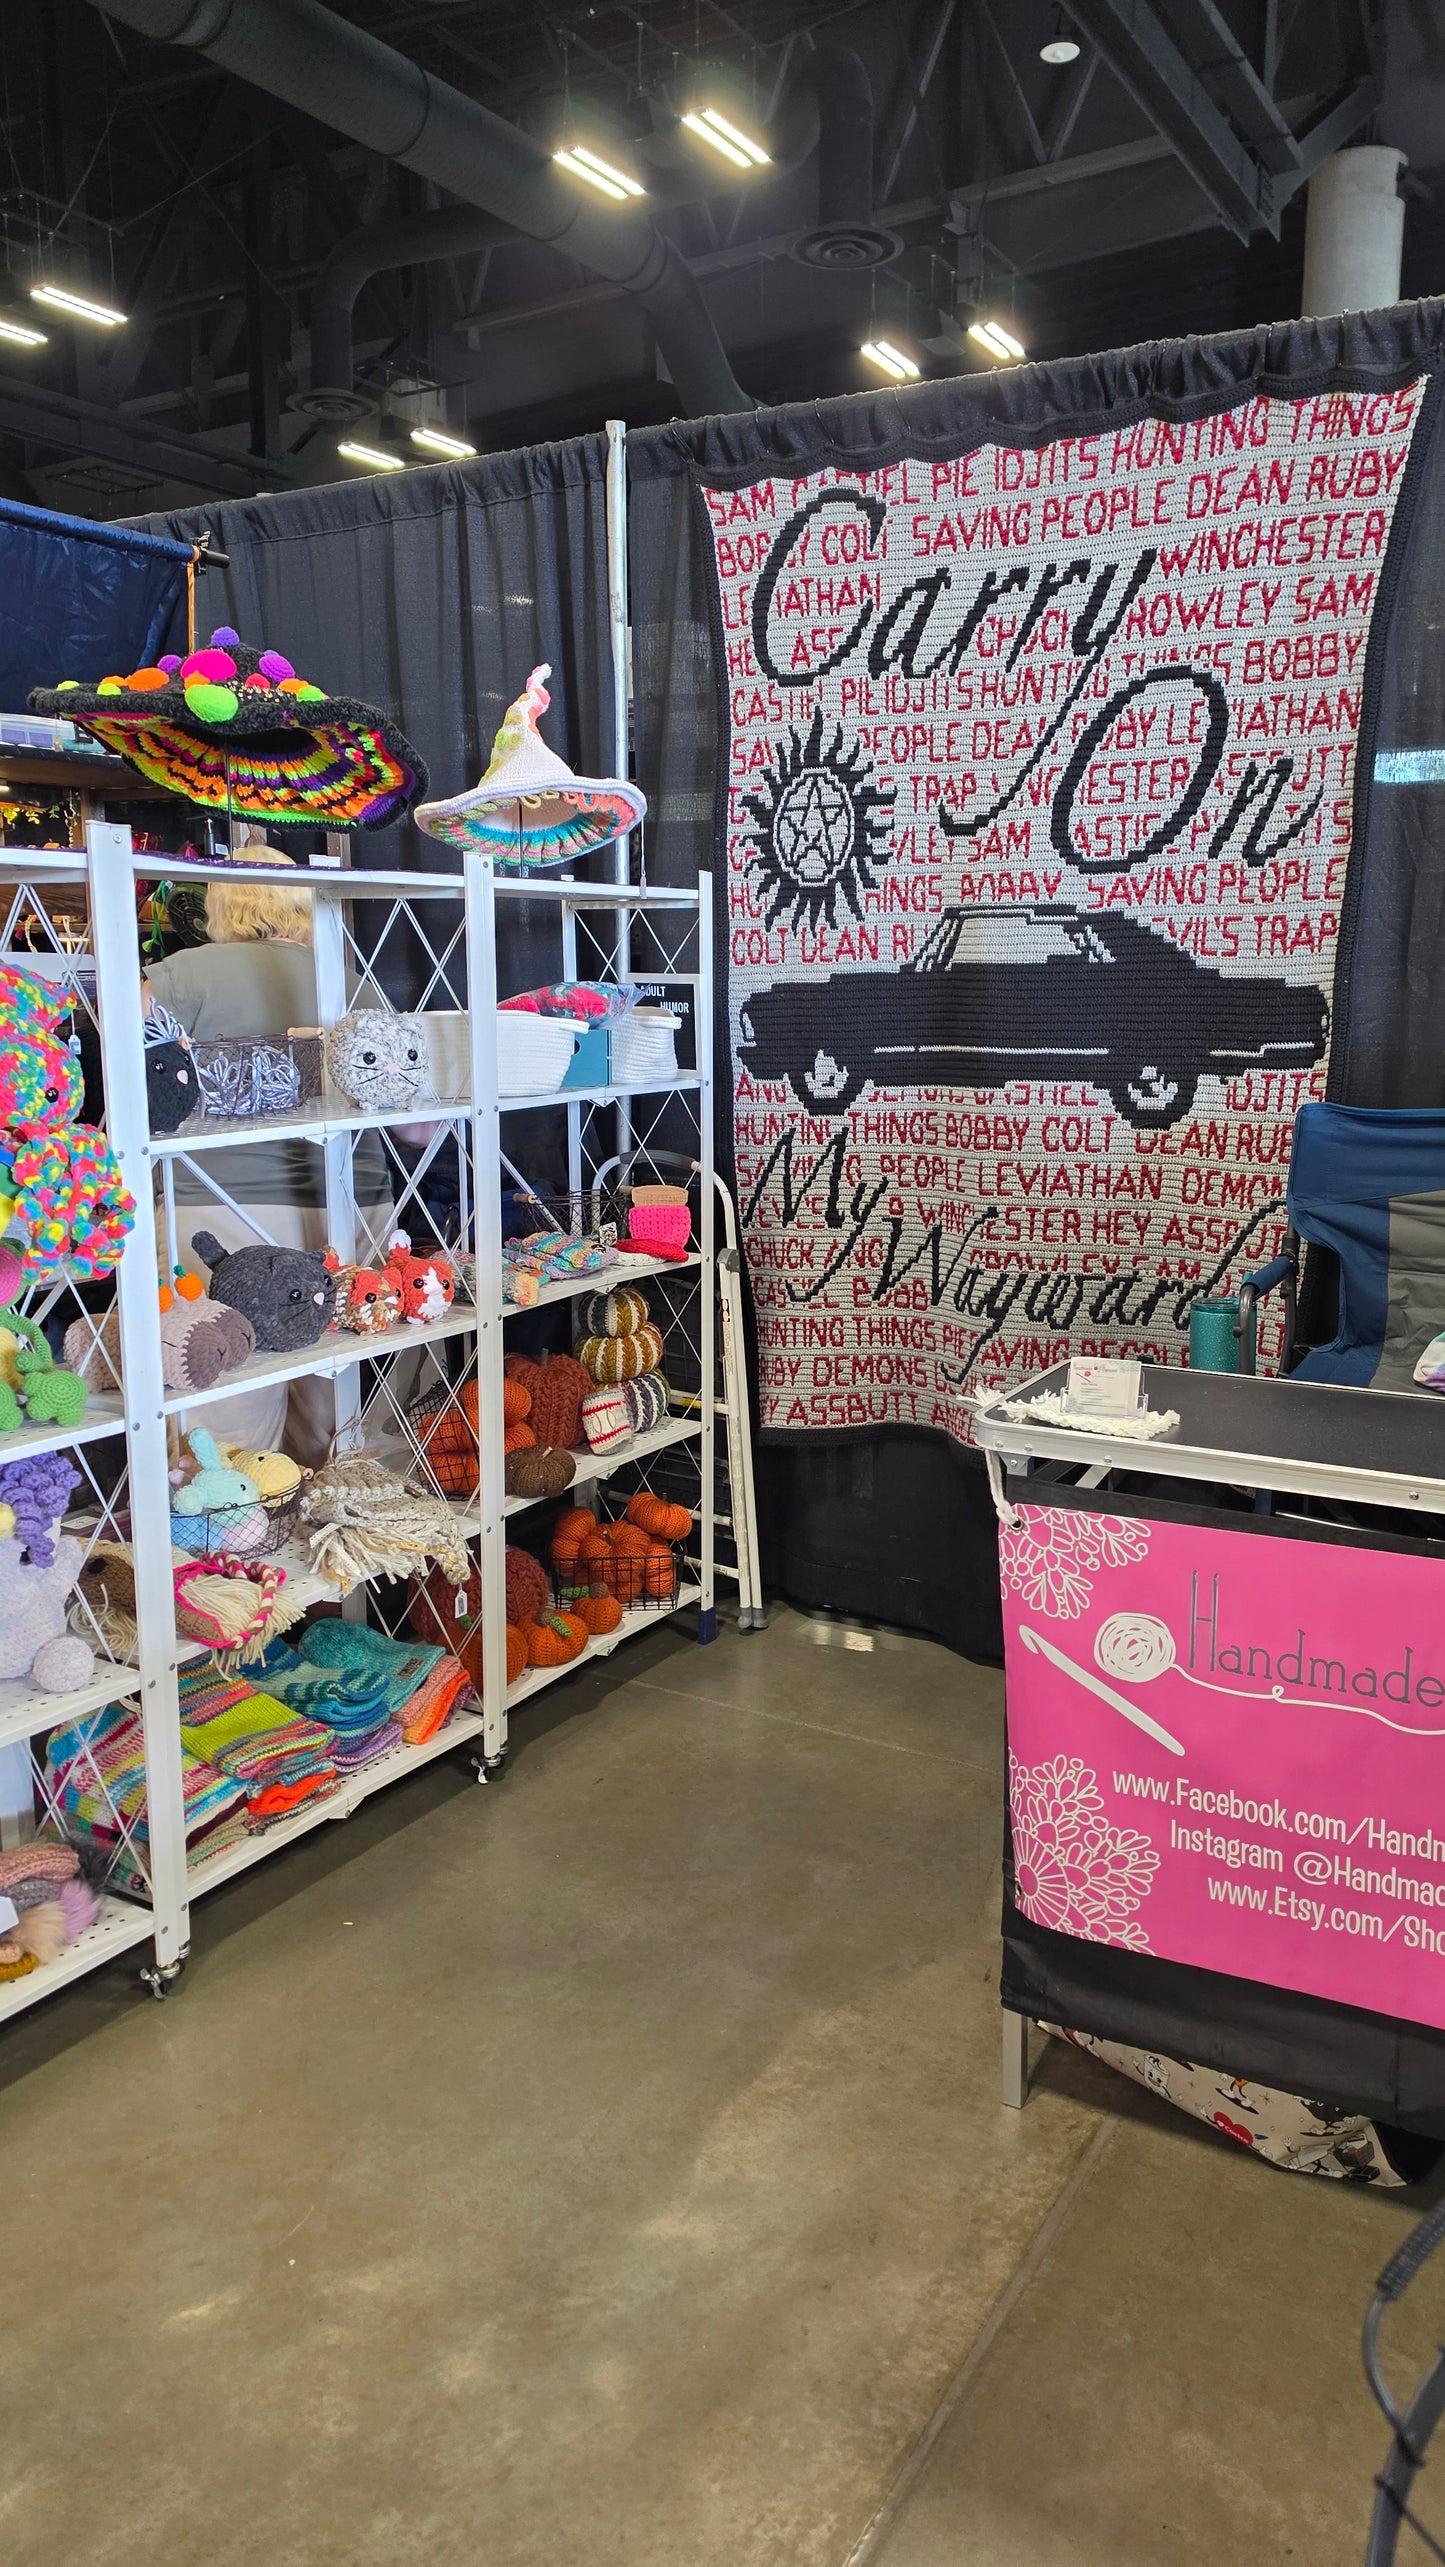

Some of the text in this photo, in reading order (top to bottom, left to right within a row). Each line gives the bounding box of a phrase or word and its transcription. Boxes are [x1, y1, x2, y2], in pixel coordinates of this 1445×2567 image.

[703, 480, 776, 527] SAM
[931, 450, 979, 502] PIE
[994, 436, 1100, 492] IDJITS
[1110, 394, 1270, 475] HUNTING
[1289, 379, 1421, 444] THINGS
[912, 502, 1032, 558] SAVING
[1040, 478, 1176, 542] PEOPLE
[1186, 459, 1296, 521] DEAN
[1305, 445, 1407, 501] RUBY
[1159, 509, 1387, 580] WINCHESTER
[1293, 571, 1375, 625] SAM
[752, 486, 1160, 838] Carry
[1243, 631, 1364, 686] BOBBY
[1050, 663, 1324, 875] On
[1217, 856, 1347, 905] PEOPLE
[1253, 911, 1339, 957] TRAP
[847, 1111, 938, 1146] THINGS
[945, 1112, 1030, 1153] BOBBY
[1042, 1115, 1118, 1154] COLT
[978, 1160, 1163, 1201] LEVIATHAN
[741, 1126, 889, 1304] My
[1091, 1207, 1151, 1246] HEY
[744, 1236, 815, 1270] CHUCK
[852, 1316, 937, 1352] THINGS
[812, 1354, 928, 1389] DEMONS
[785, 1392, 918, 1426] ASSBUTT
[1188, 1569, 1445, 1708] Handmade
[1170, 1819, 1284, 1873] Instagram
